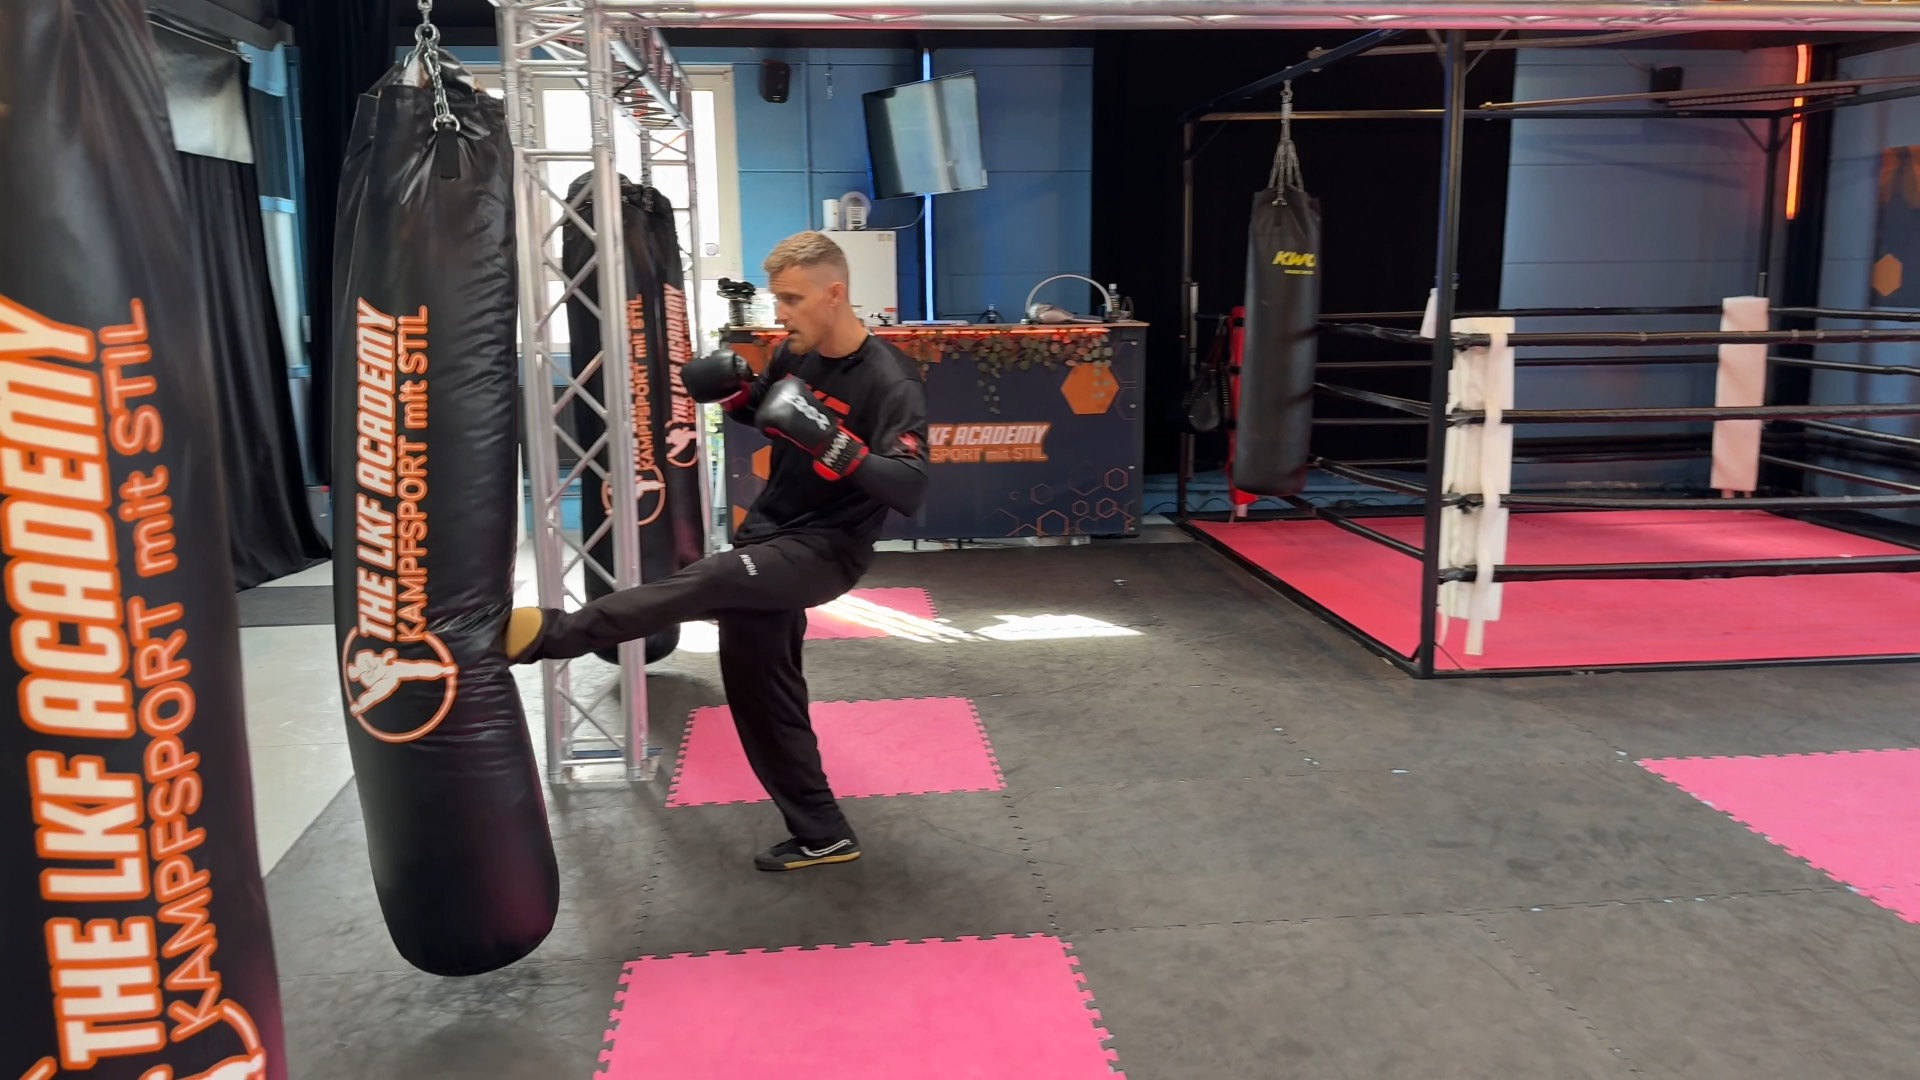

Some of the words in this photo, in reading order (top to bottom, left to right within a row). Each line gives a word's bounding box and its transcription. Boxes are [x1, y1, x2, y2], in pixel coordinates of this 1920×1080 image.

[1272, 250, 1316, 268] KWO
[98, 298, 164, 455] STIL
[397, 304, 428, 375] STIL
[355, 296, 396, 498] ACADEMY
[399, 380, 428, 429] mit
[632, 362, 655, 470] KAMPFSPORT
[927, 424, 953, 446] KF
[951, 423, 1051, 446] ACADEMY
[929, 447, 981, 463] SPORT
[1012, 447, 1048, 461] STIL
[0, 294, 136, 739] ACADEMY
[118, 465, 178, 577] mit
[356, 493, 396, 571] LKF
[397, 434, 428, 643] KAMPFSPORT
[356, 566, 396, 642] THE
[27, 750, 150, 900] LKF
[127, 595, 221, 1042] KAMPFSPORT
[45, 916, 167, 1070] THE
